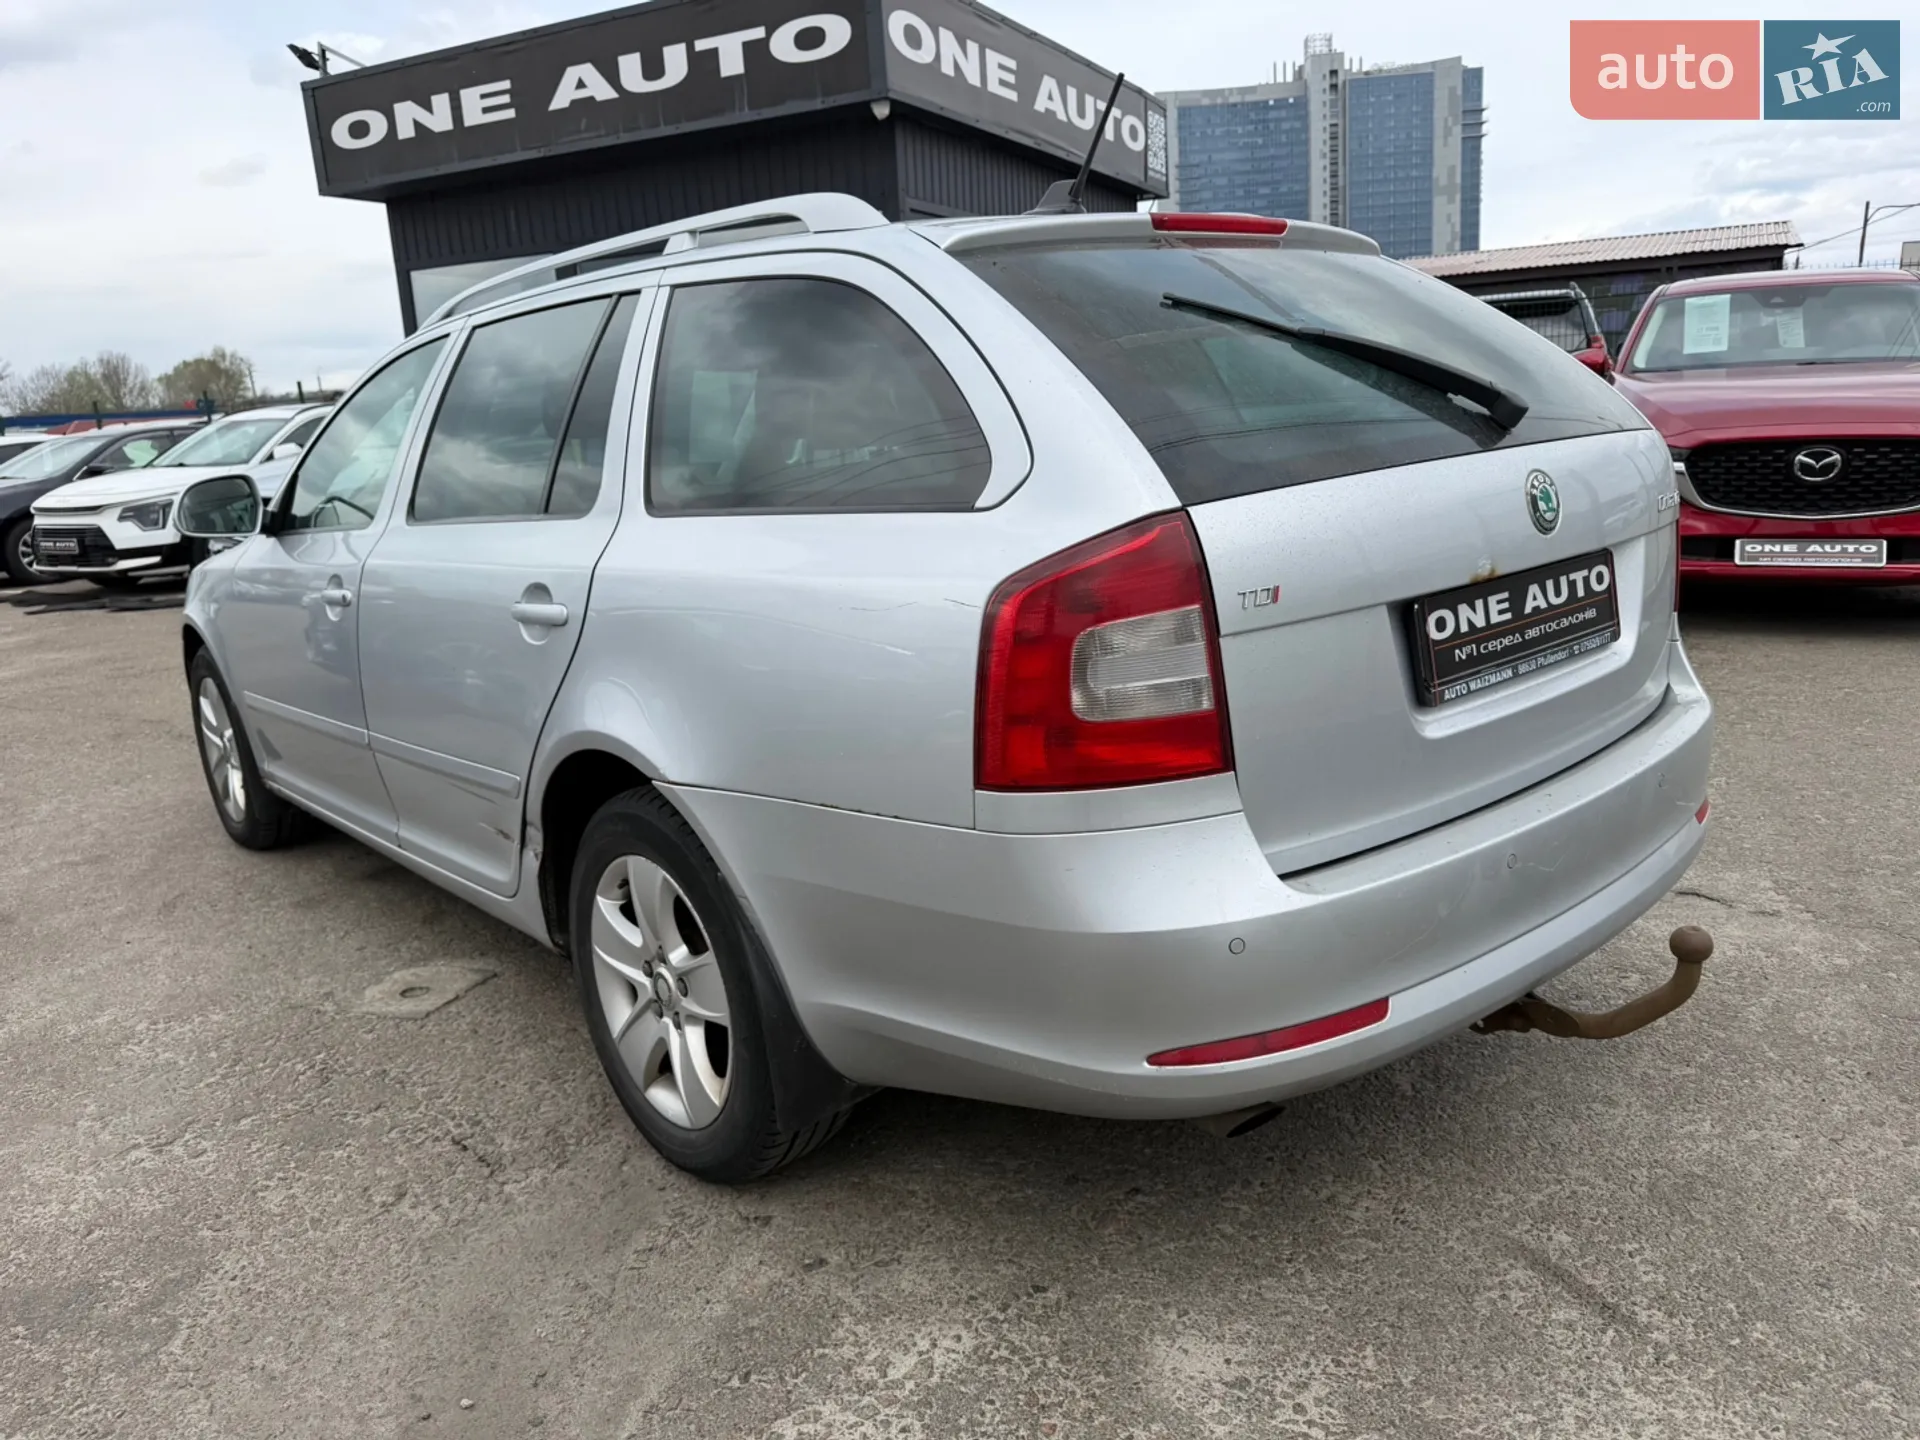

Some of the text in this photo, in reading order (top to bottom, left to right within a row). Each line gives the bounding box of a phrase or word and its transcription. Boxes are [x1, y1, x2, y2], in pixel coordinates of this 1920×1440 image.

[331, 13, 853, 150] ONE AUTO
[887, 9, 1147, 152] ONE AUTO
[1745, 544, 1878, 553] ONE AUTO
[1237, 583, 1281, 610] TDI
[1426, 565, 1611, 641] ONE AUTO
[1454, 607, 1597, 662] №1 серед автосалонів
[1444, 683, 1468, 701] AUTO
[1468, 667, 1513, 692] WAIZMANN
